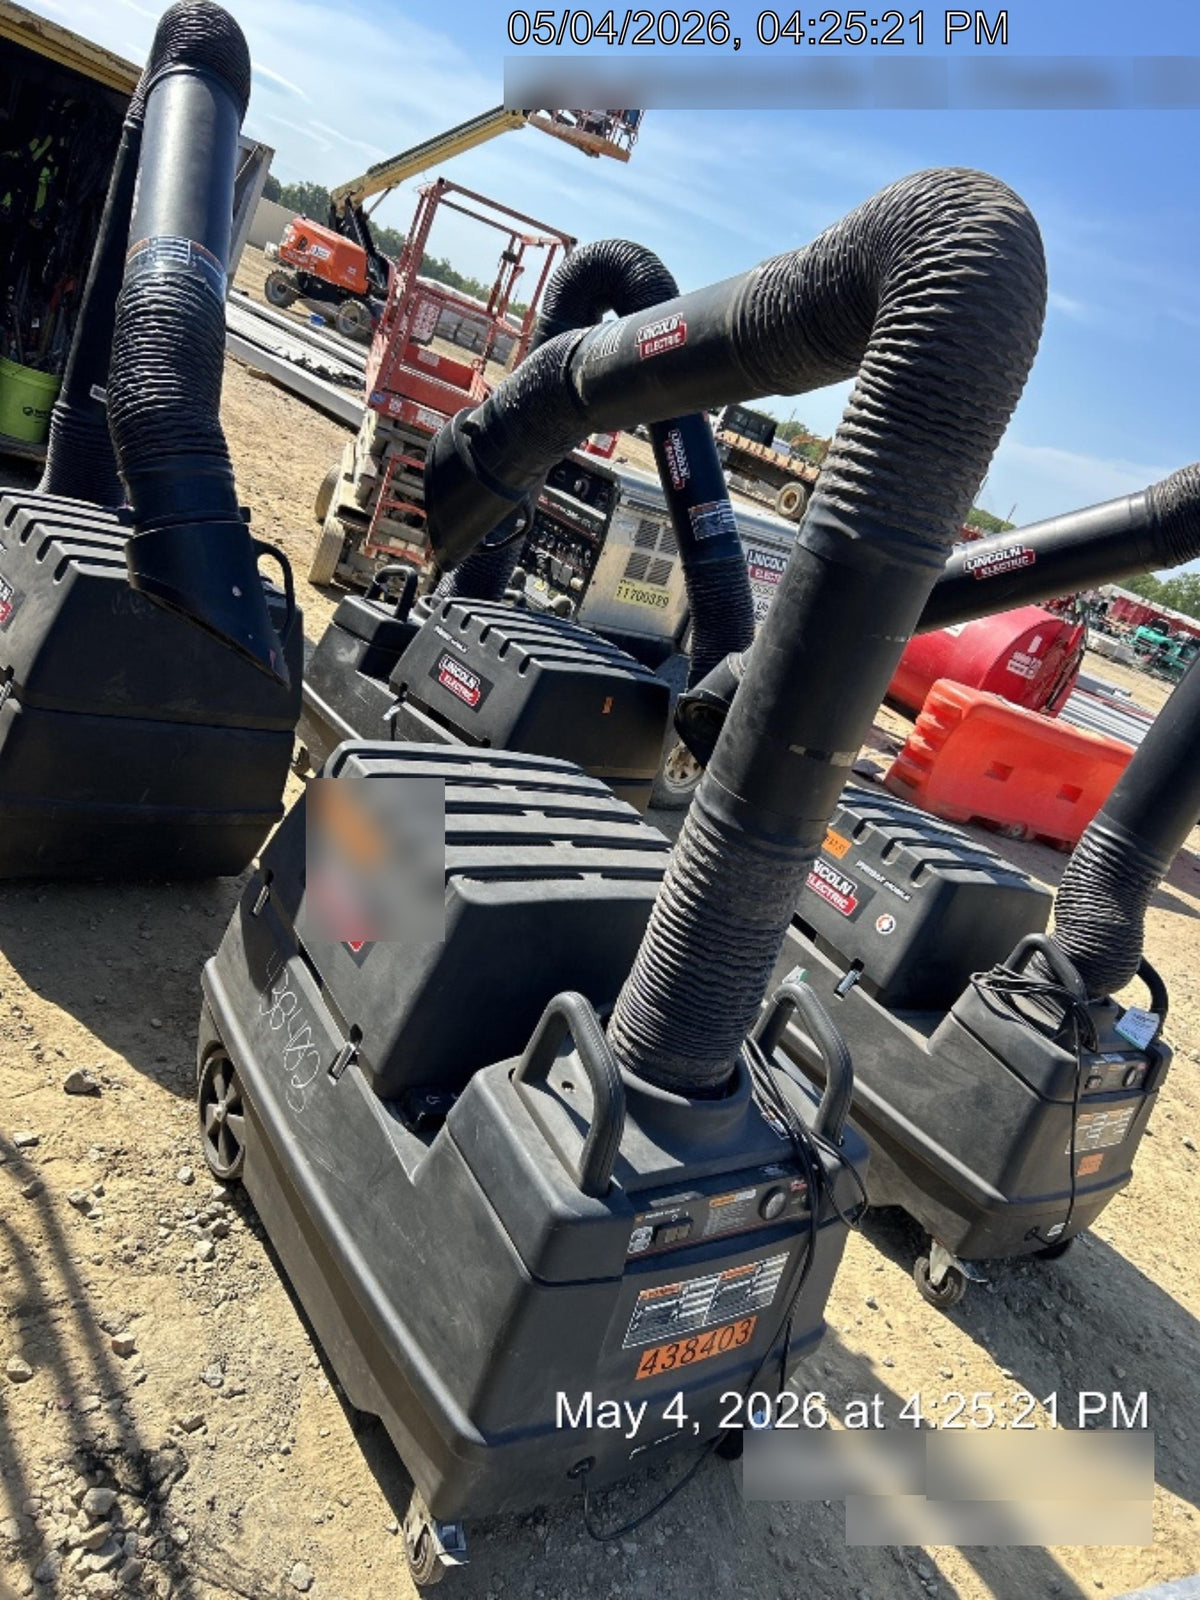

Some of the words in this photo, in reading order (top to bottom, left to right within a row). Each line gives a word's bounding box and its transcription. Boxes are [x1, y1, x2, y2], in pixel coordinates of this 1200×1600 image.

[636, 314, 682, 343] LINCOLN
[644, 332, 681, 355] ELECTRIC
[966, 545, 1023, 570] LINCOLN
[980, 555, 1029, 576] ELECTRIC
[441, 657, 478, 689] LINCOLN
[443, 673, 475, 699] ELECTRIC
[813, 859, 853, 895] NCOLN
[640, 1318, 752, 1376] 438403
